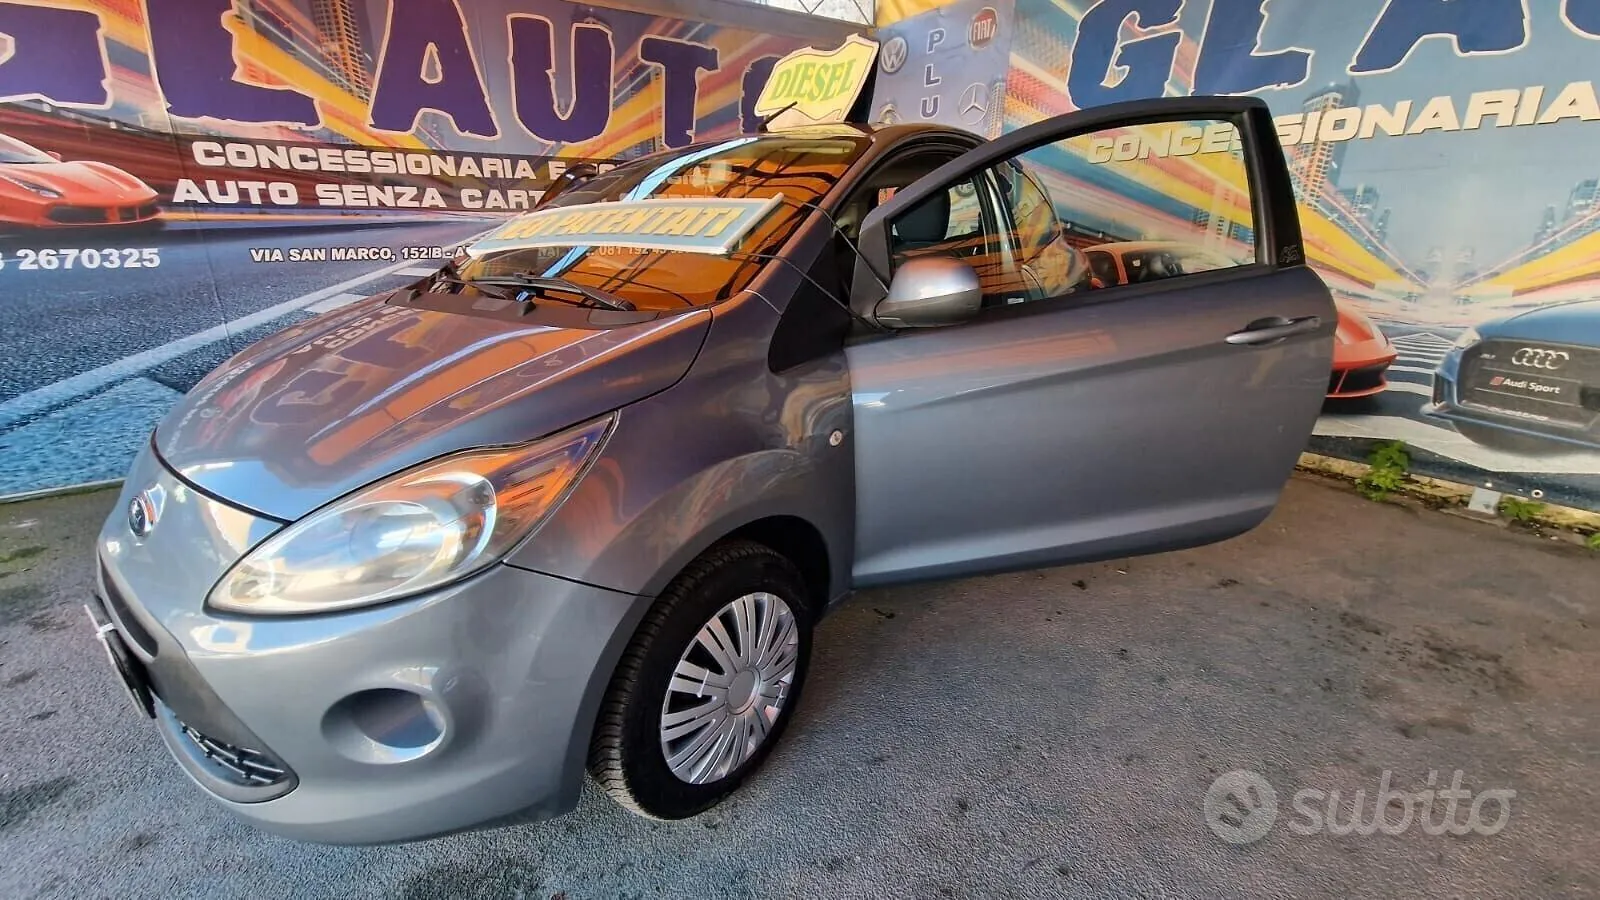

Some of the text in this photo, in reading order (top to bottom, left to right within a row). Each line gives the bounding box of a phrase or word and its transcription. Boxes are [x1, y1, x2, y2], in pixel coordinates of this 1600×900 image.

[973, 18, 996, 41] FIAT
[769, 59, 857, 102] DIESEL
[191, 141, 537, 180] CONCESSIONARIA
[172, 178, 299, 206] AUTO
[315, 183, 447, 208] SENZA
[16, 248, 161, 270] 2670325
[250, 248, 285, 263] VIA
[289, 248, 327, 262] SAN
[331, 247, 397, 263] MARCO,
[1502, 378, 1561, 394] Audi Sport
